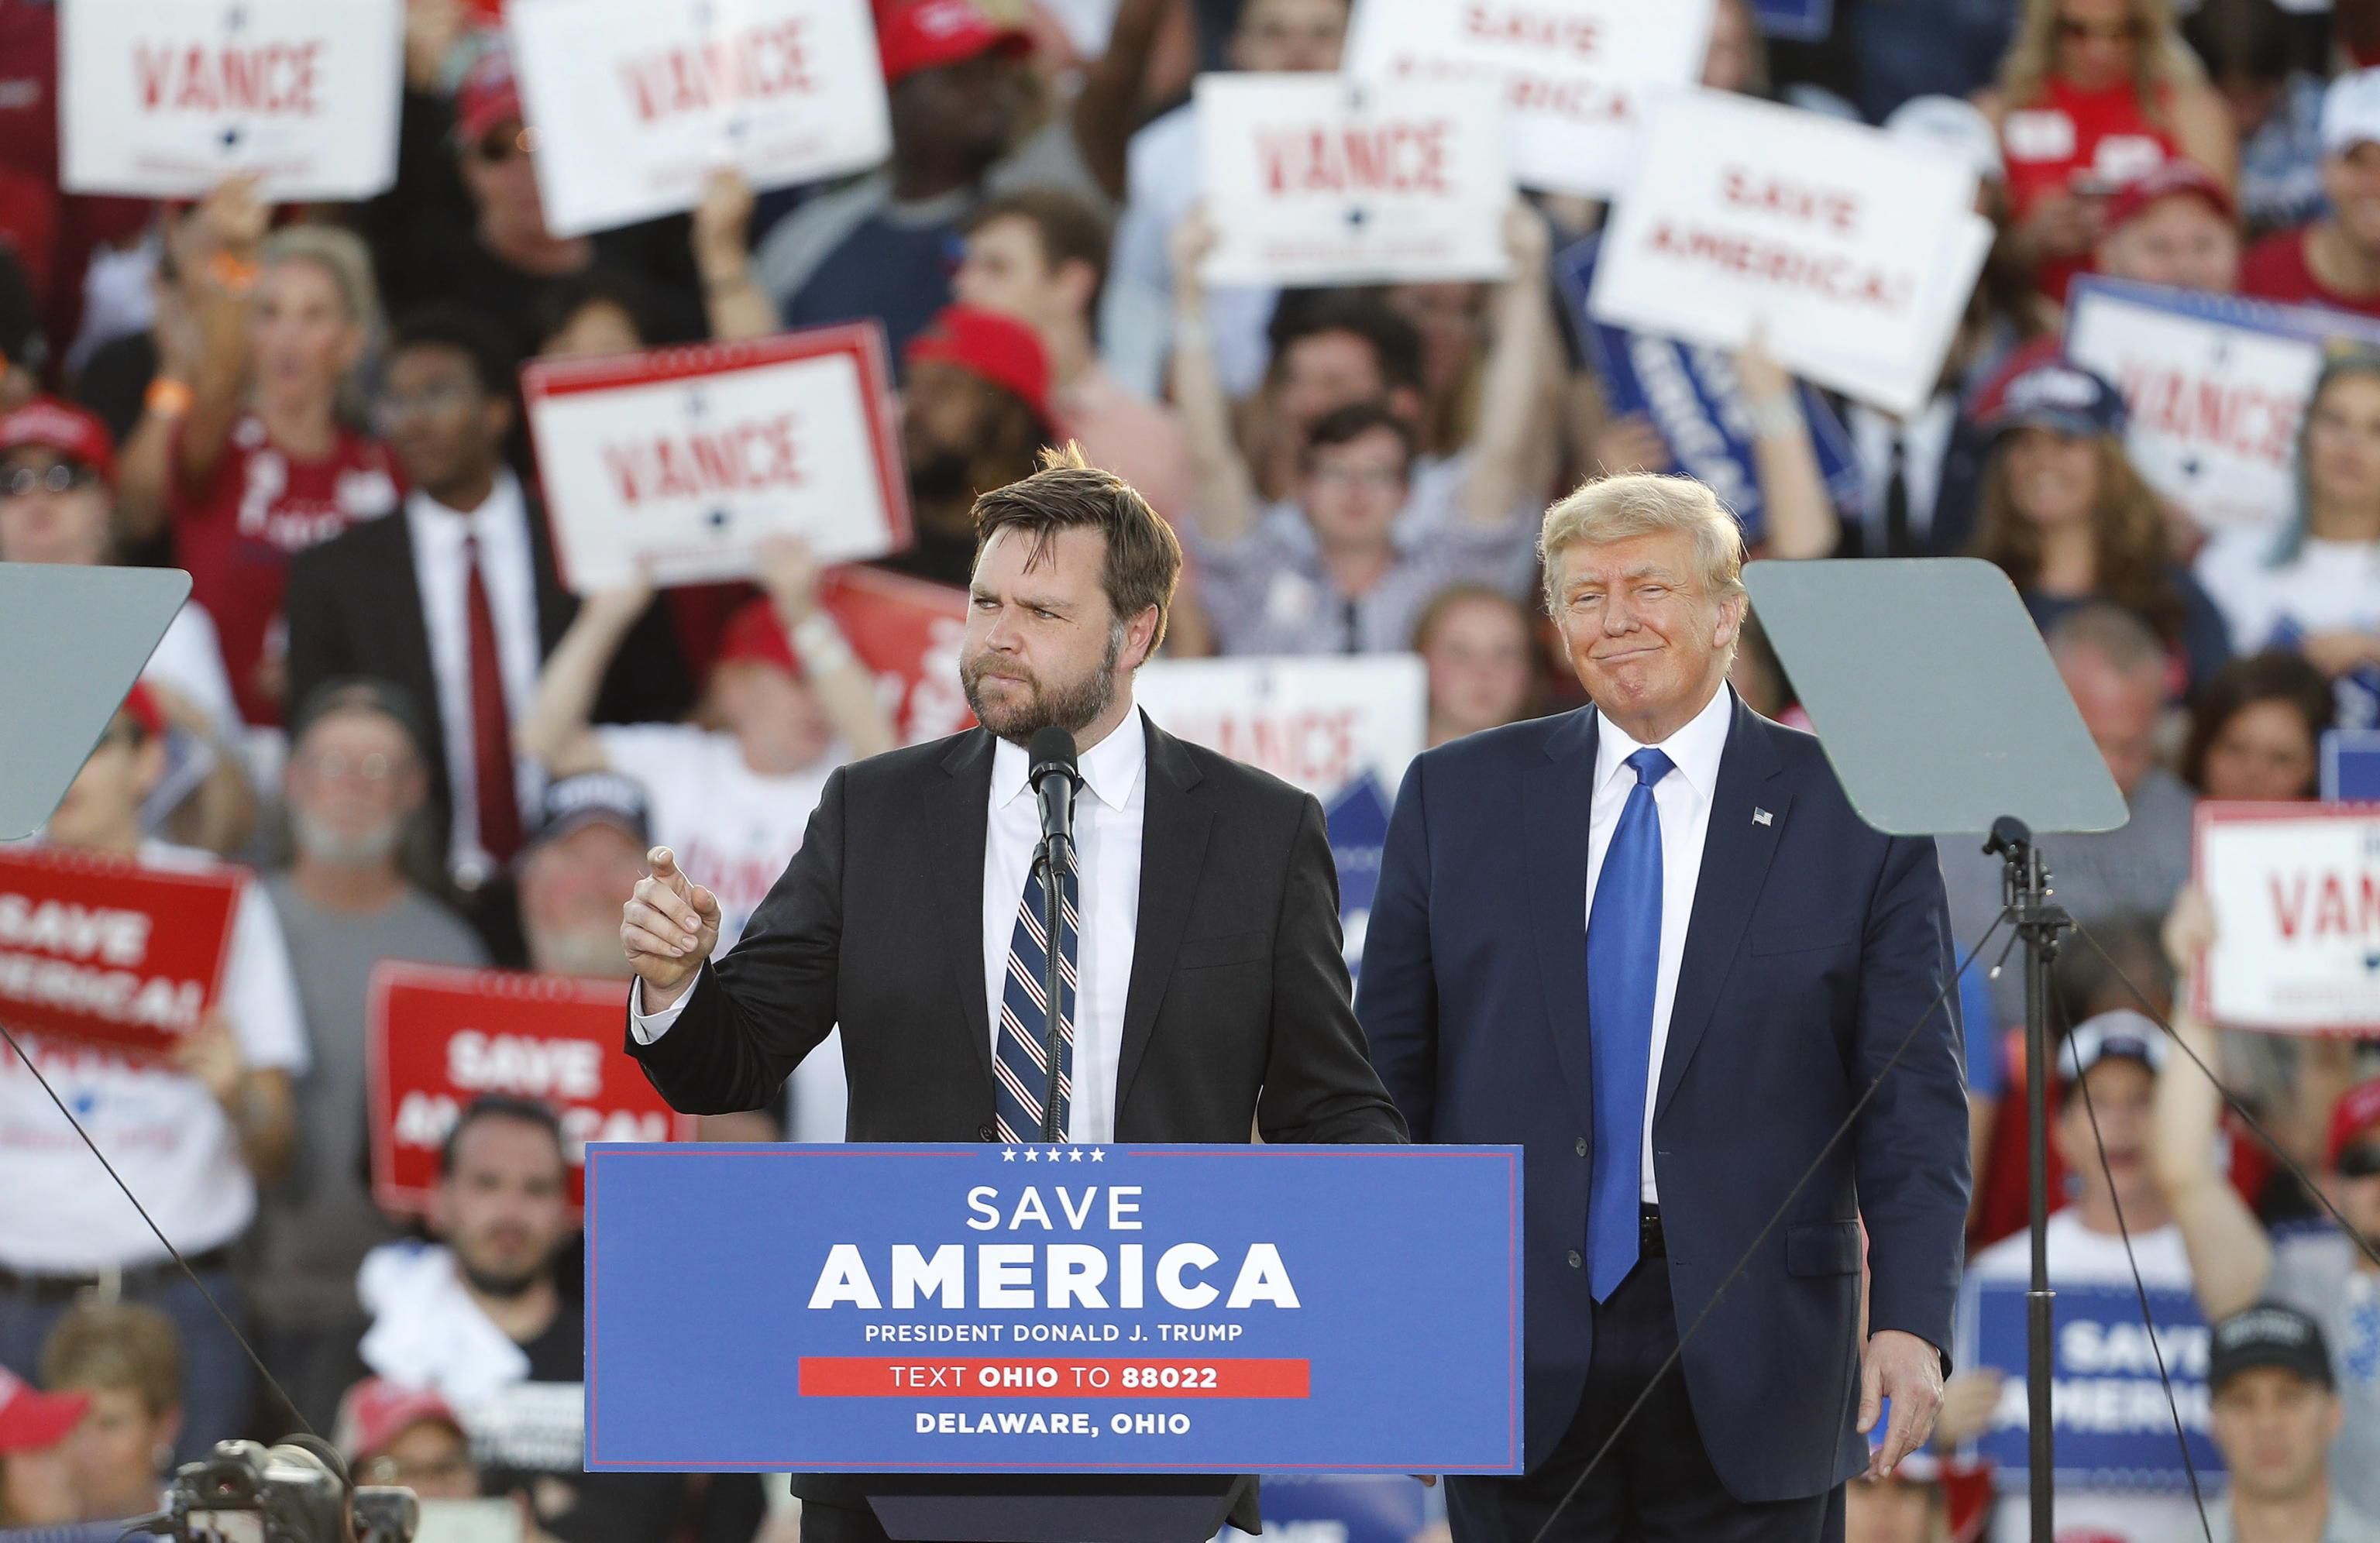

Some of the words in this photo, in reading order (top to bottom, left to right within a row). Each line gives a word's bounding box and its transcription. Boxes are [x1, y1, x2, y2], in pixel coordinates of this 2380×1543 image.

[132, 39, 325, 115] VANCE
[621, 17, 817, 122] VANCE
[1254, 118, 1453, 197] VANCE
[1720, 164, 1859, 230] SAVE
[1646, 215, 1914, 306] AMERICA!
[600, 414, 807, 505] VANCE
[447, 1029, 603, 1099] SAVE
[967, 1186, 1143, 1230] SAVE
[808, 1242, 1301, 1309] AMERICA
[865, 1325, 1003, 1342] PRESIDENT
[1013, 1325, 1119, 1342] DONALD
[1129, 1325, 1147, 1342] J.
[1157, 1325, 1243, 1342] TRUMP
[889, 1366, 967, 1388] TEXT
[978, 1366, 1058, 1388] OHIO
[1070, 1366, 1109, 1388] TO
[1122, 1366, 1217, 1388] 88022
[916, 1413, 1098, 1438] DELAWARE,
[1110, 1413, 1191, 1435] OHIO
